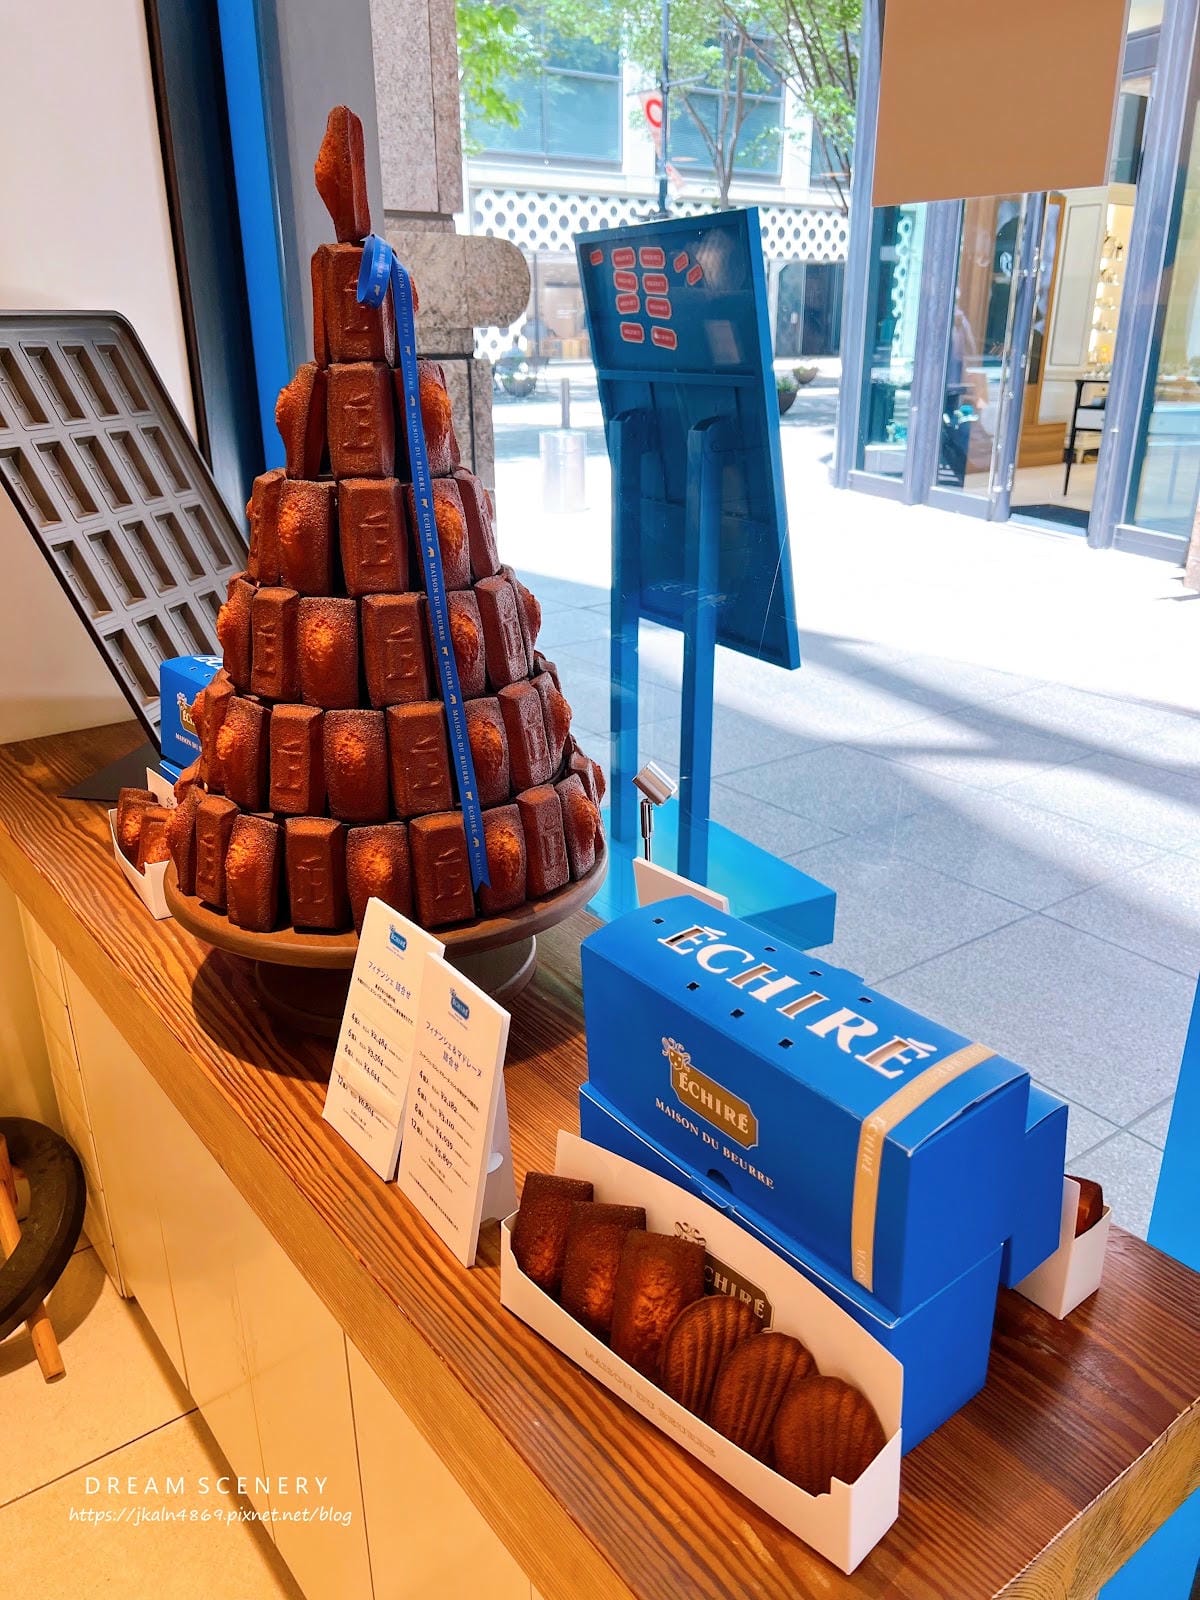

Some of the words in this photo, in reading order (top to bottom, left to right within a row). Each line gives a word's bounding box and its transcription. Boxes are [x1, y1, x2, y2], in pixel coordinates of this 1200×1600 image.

[411, 412, 419, 444] MAISON
[414, 446, 421, 458] DU
[416, 461, 426, 492] BEURRE
[430, 562, 439, 593] MAISON
[434, 596, 441, 607] DU
[436, 610, 446, 640] BEURRE
[453, 709, 463, 740] MAISON
[458, 742, 465, 753] DU
[460, 756, 470, 785] BEURRE
[657, 924, 938, 1080] ÉCHIRÉ
[678, 1071, 749, 1135] ÉCHIRÉ
[655, 1097, 699, 1137] MAISON
[702, 1131, 719, 1150] DU
[722, 1146, 775, 1190] BEURRE
